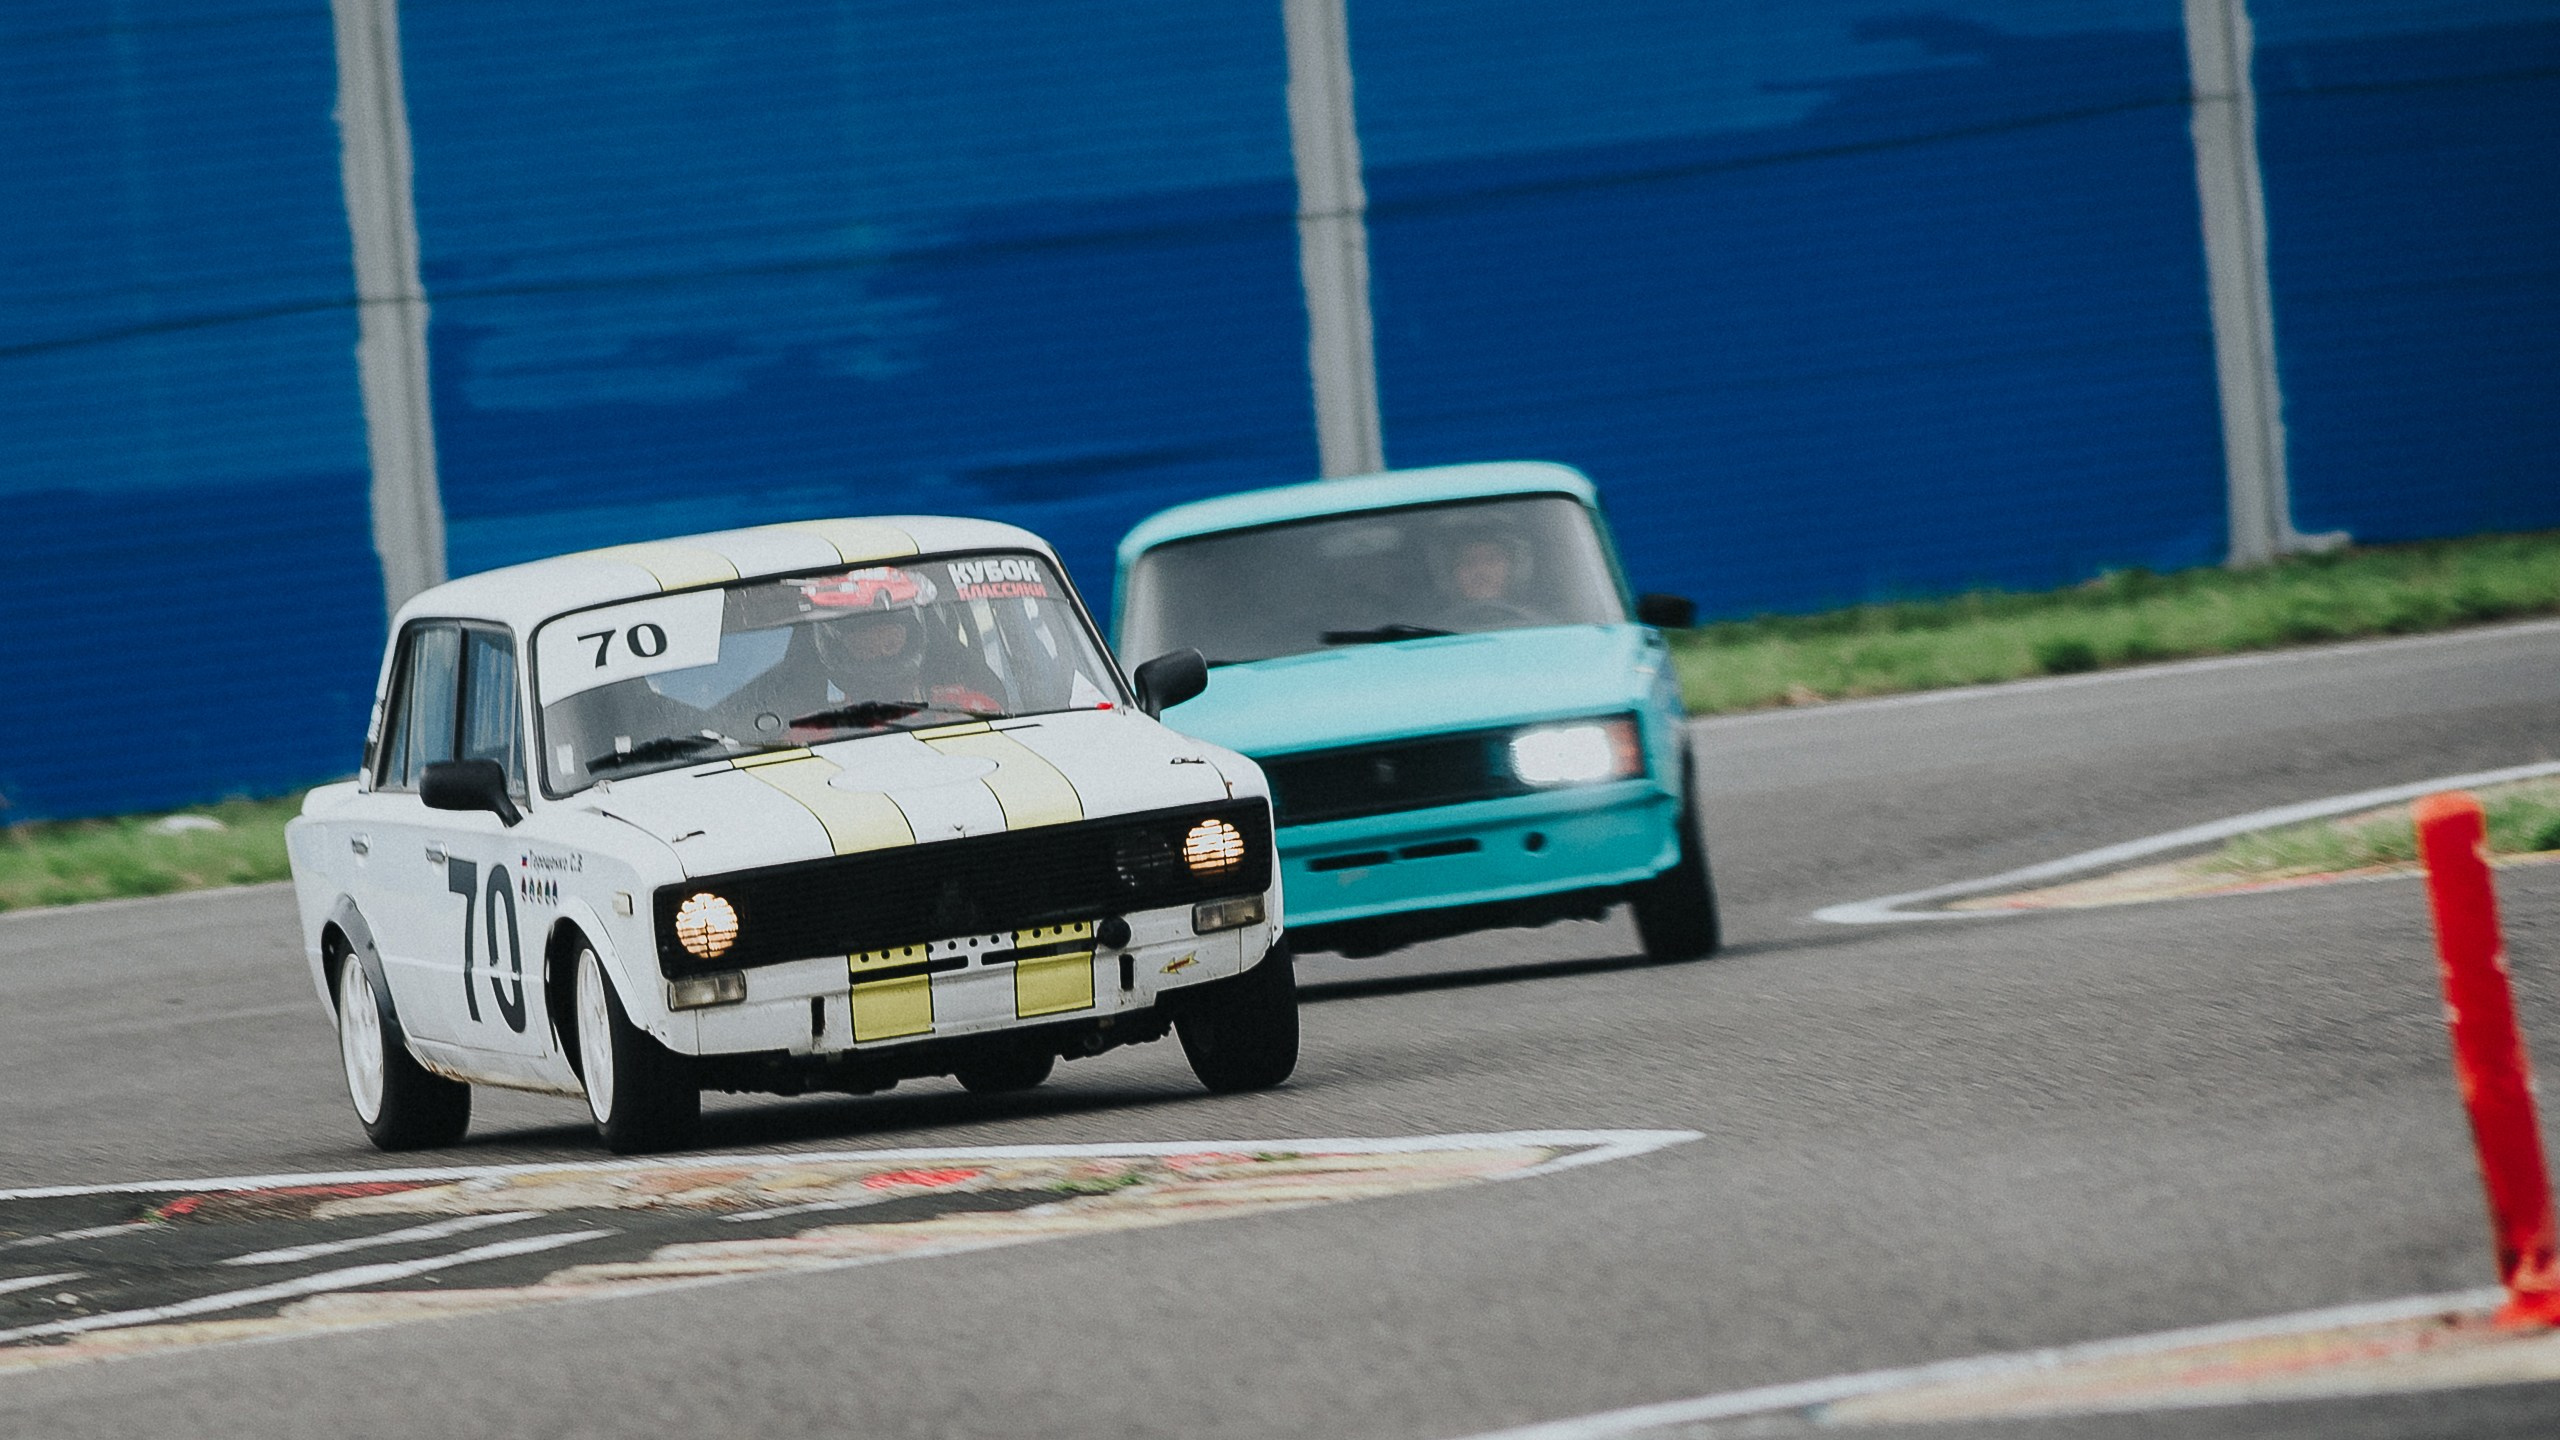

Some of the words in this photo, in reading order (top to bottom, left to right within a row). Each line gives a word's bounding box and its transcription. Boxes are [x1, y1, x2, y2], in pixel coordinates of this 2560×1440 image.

[947, 559, 1041, 588] КУБОК
[956, 581, 1048, 601] КЛАССИКИ
[576, 623, 668, 671] 70
[448, 857, 527, 1034] 70
